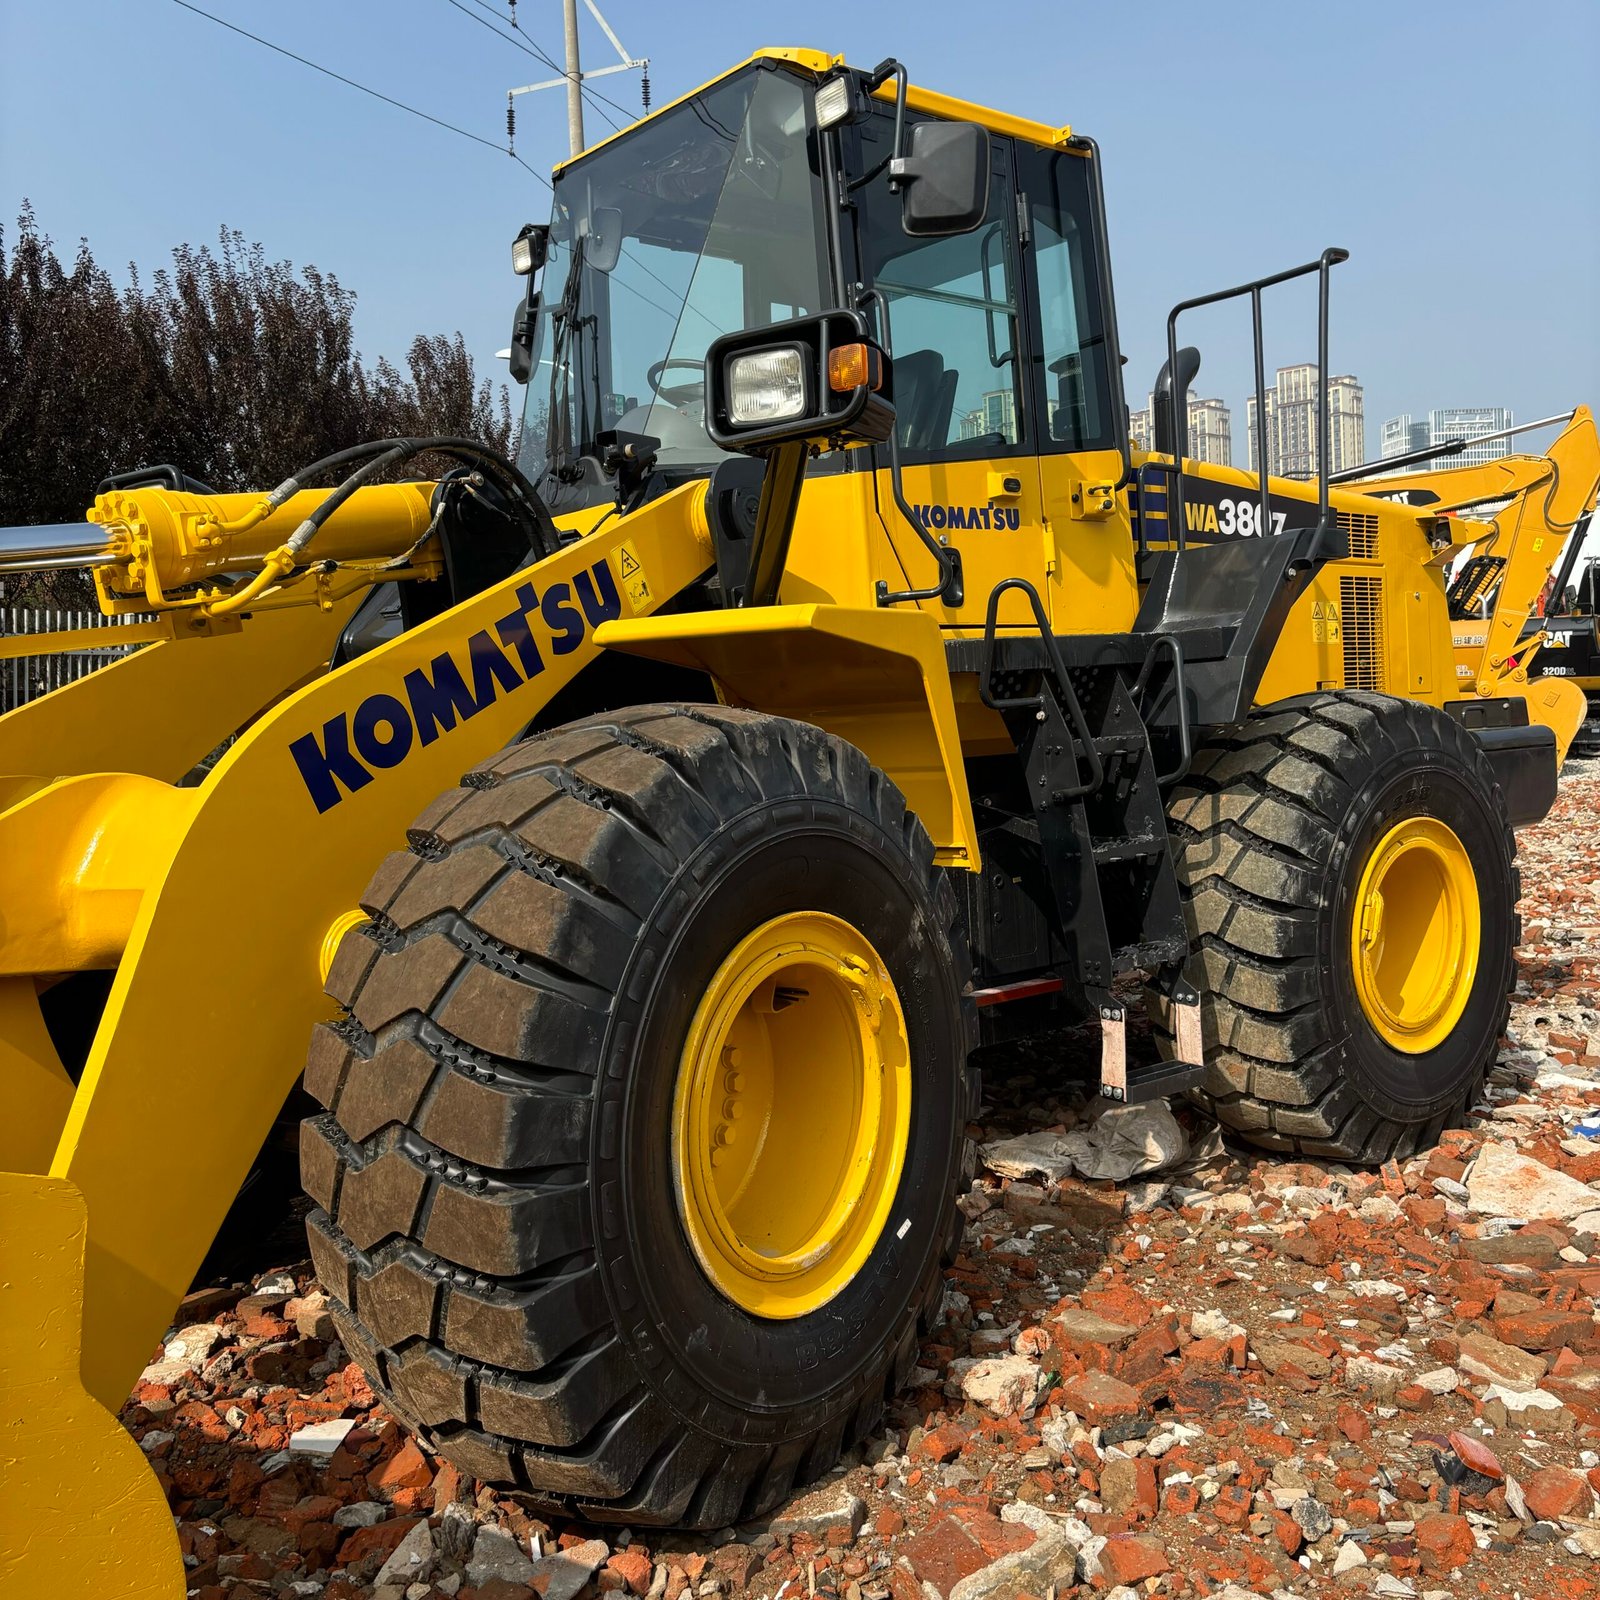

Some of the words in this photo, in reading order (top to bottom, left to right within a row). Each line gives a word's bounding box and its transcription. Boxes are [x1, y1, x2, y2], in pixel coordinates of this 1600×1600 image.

[1382, 491, 1410, 505] AT
[913, 502, 1020, 531] KOMATSU
[1542, 631, 1573, 649] CAT
[288, 558, 622, 815] KOMATSU
